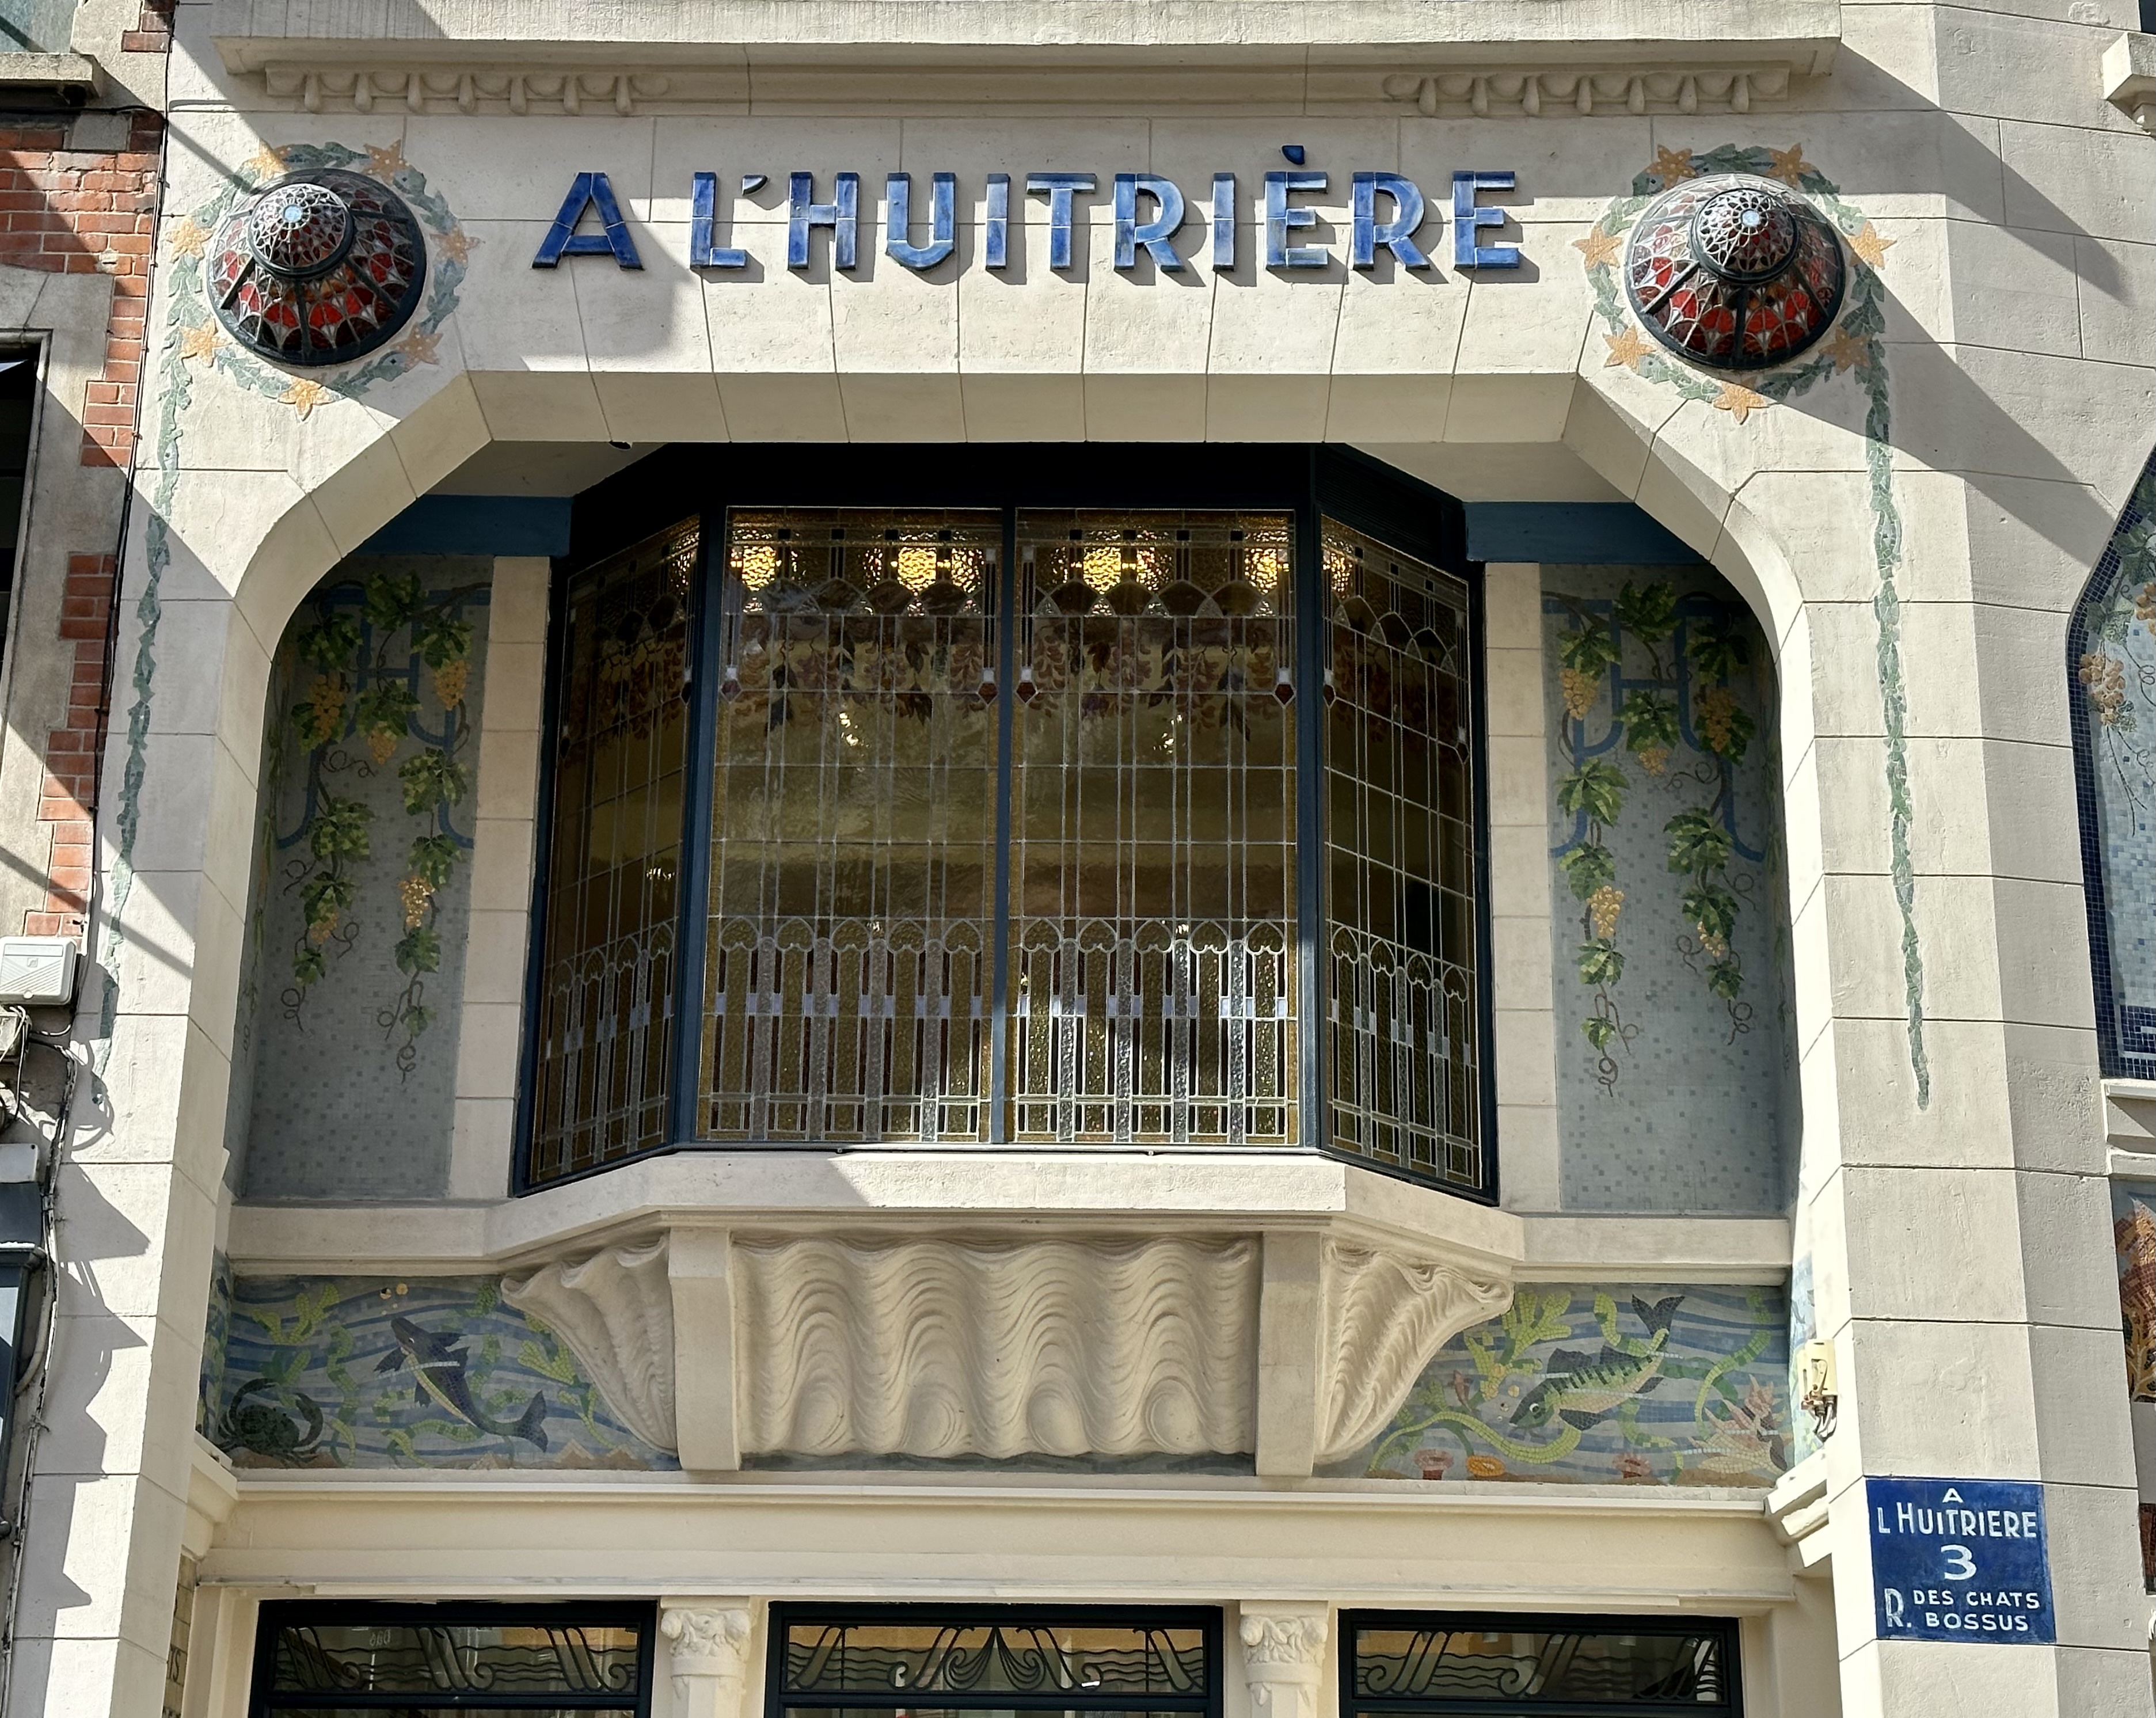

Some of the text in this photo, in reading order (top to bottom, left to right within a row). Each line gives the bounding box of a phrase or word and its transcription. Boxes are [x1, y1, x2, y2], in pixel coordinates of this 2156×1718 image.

[532, 172, 644, 271] A
[1942, 1488, 1964, 1503] A
[1940, 1544, 1977, 1580] 3
[1913, 1590, 1955, 1606] DES
[1965, 1591, 2040, 1609] CHATS
[1925, 1612, 2029, 1632] BOSSUS
